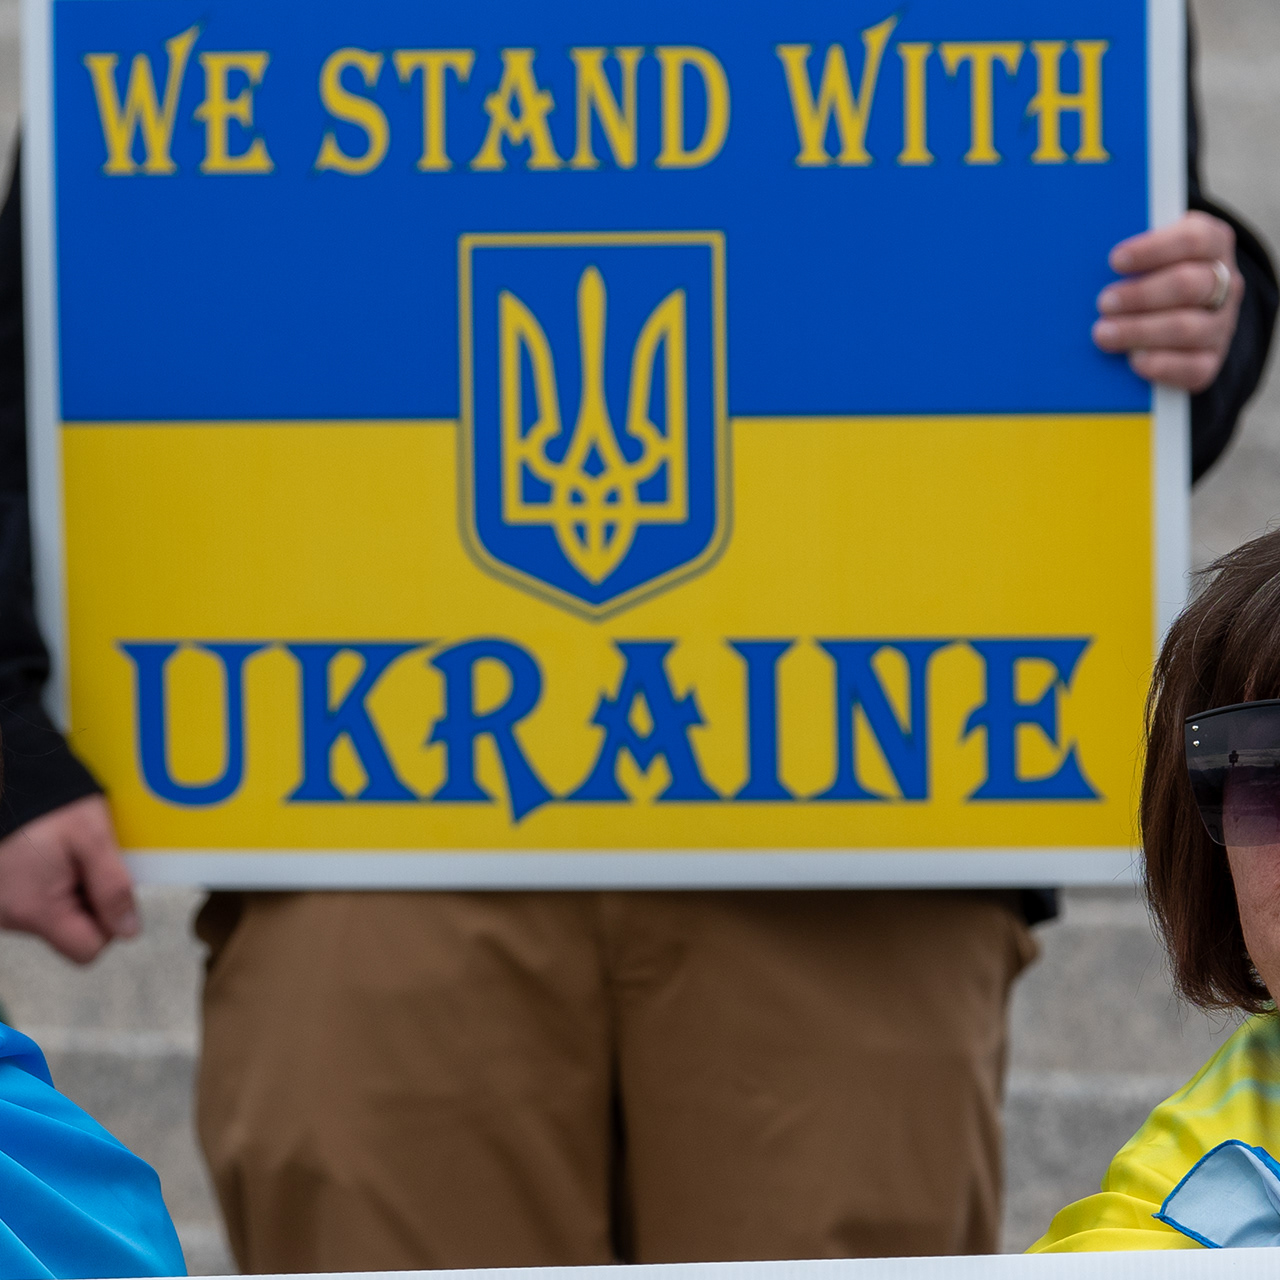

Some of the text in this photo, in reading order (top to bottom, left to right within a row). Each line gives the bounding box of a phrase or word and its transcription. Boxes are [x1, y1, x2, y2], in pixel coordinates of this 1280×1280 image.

[84, 14, 1109, 175] WE STAND WITH
[116, 636, 1104, 825] UKRAINE
